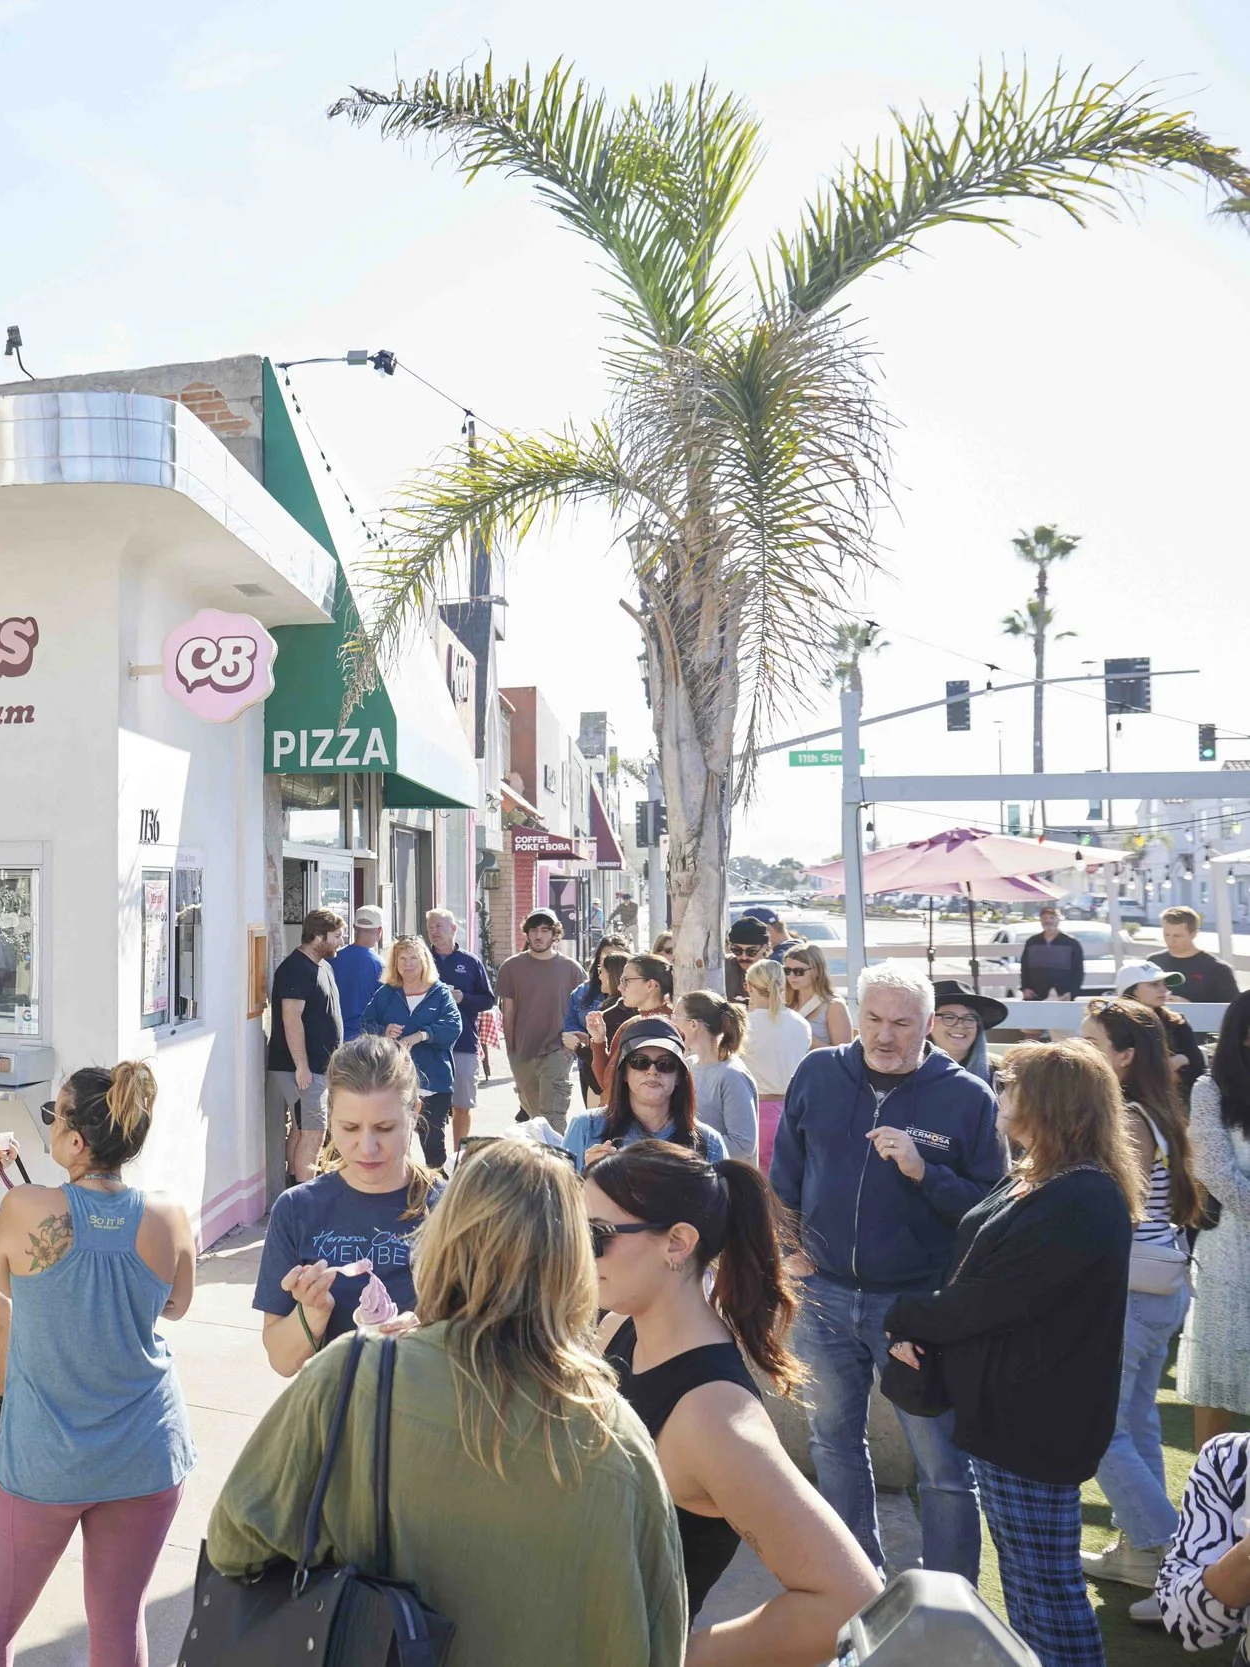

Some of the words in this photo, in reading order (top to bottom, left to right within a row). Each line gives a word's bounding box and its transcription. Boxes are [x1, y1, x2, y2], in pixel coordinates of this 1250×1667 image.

[175, 635, 258, 694] CB
[272, 727, 390, 768] PIZZA
[798, 754, 819, 763] 11th
[138, 808, 160, 845] 1136
[515, 836, 549, 844] COFFEE
[906, 1128, 950, 1145] HERMOSA
[313, 1230, 368, 1247] Hermosa
[318, 1245, 407, 1265] MEMBE
